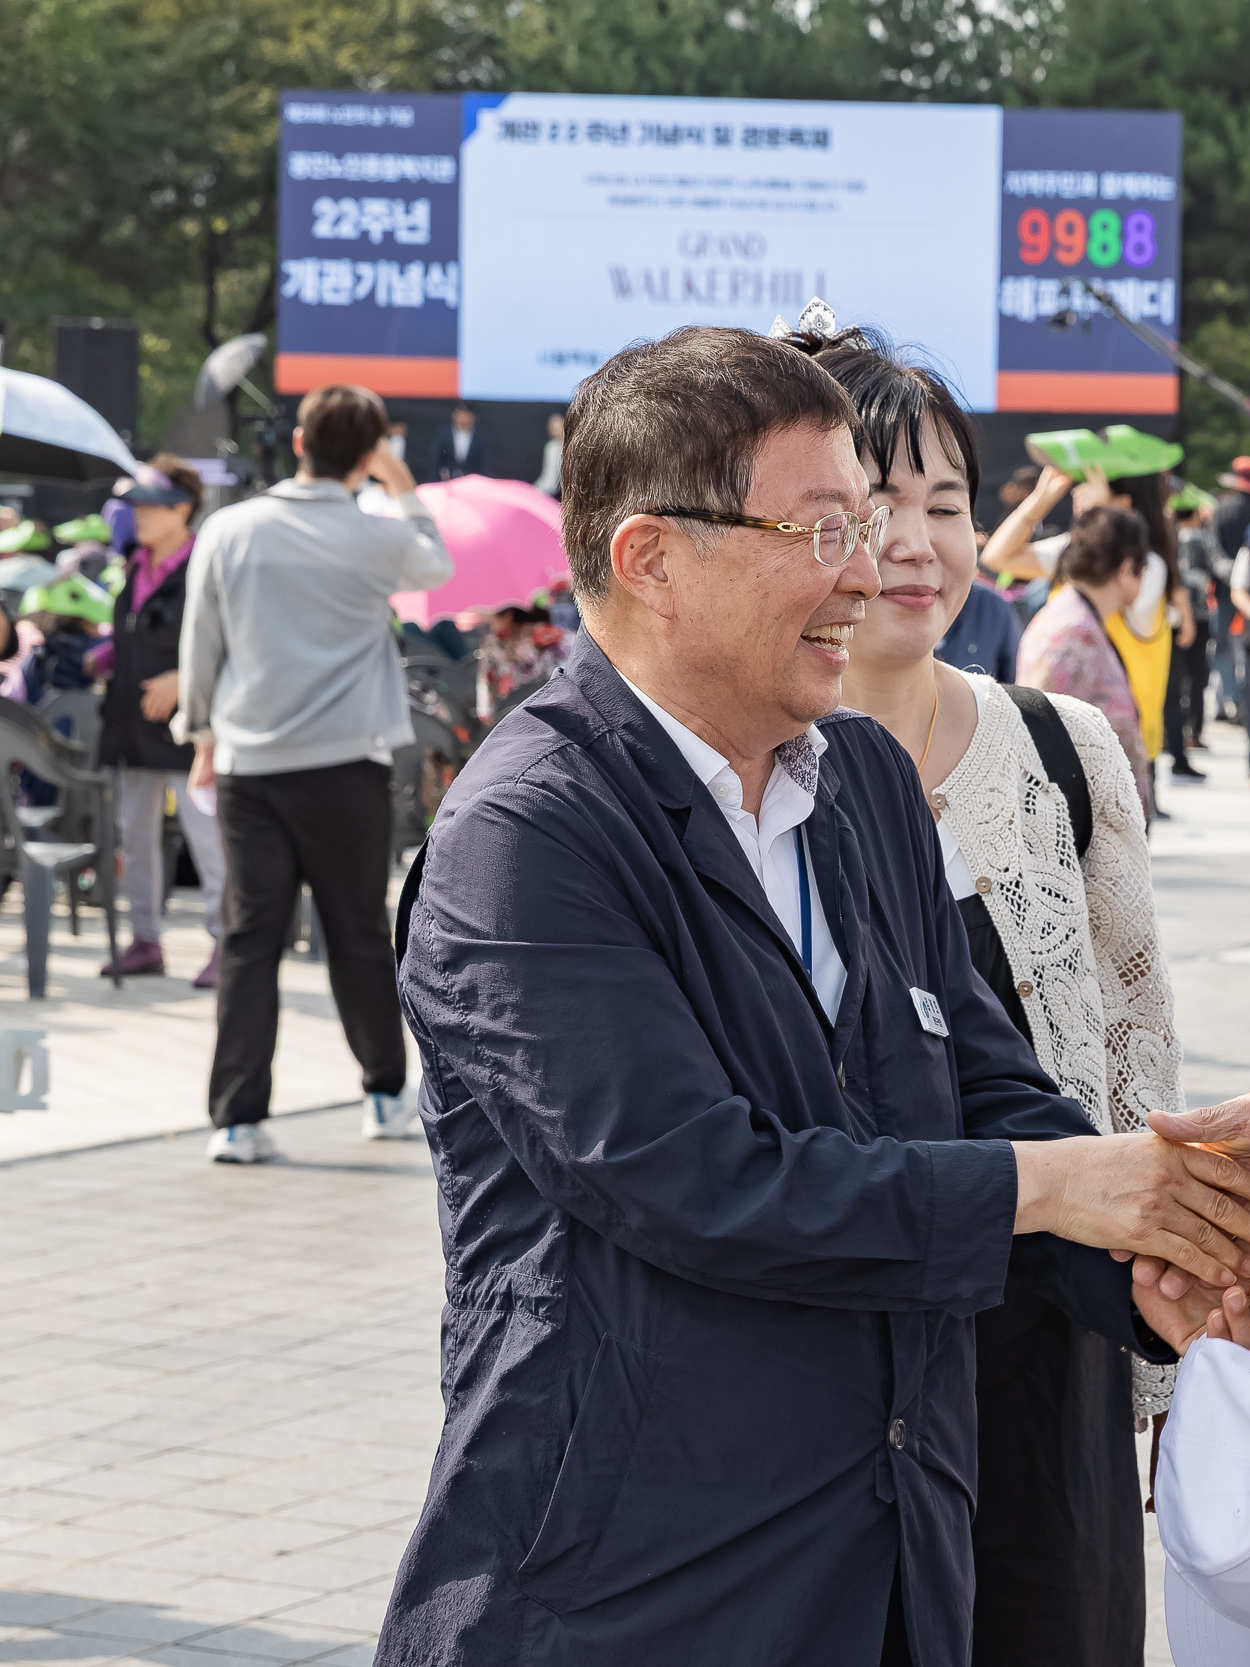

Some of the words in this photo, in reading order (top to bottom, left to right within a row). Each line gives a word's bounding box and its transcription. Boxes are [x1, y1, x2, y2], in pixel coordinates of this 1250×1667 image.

[312, 197, 432, 245] 22주년
[1018, 207, 1157, 268] 9988
[678, 230, 767, 262] GRAND
[281, 259, 459, 308] 개관기념식
